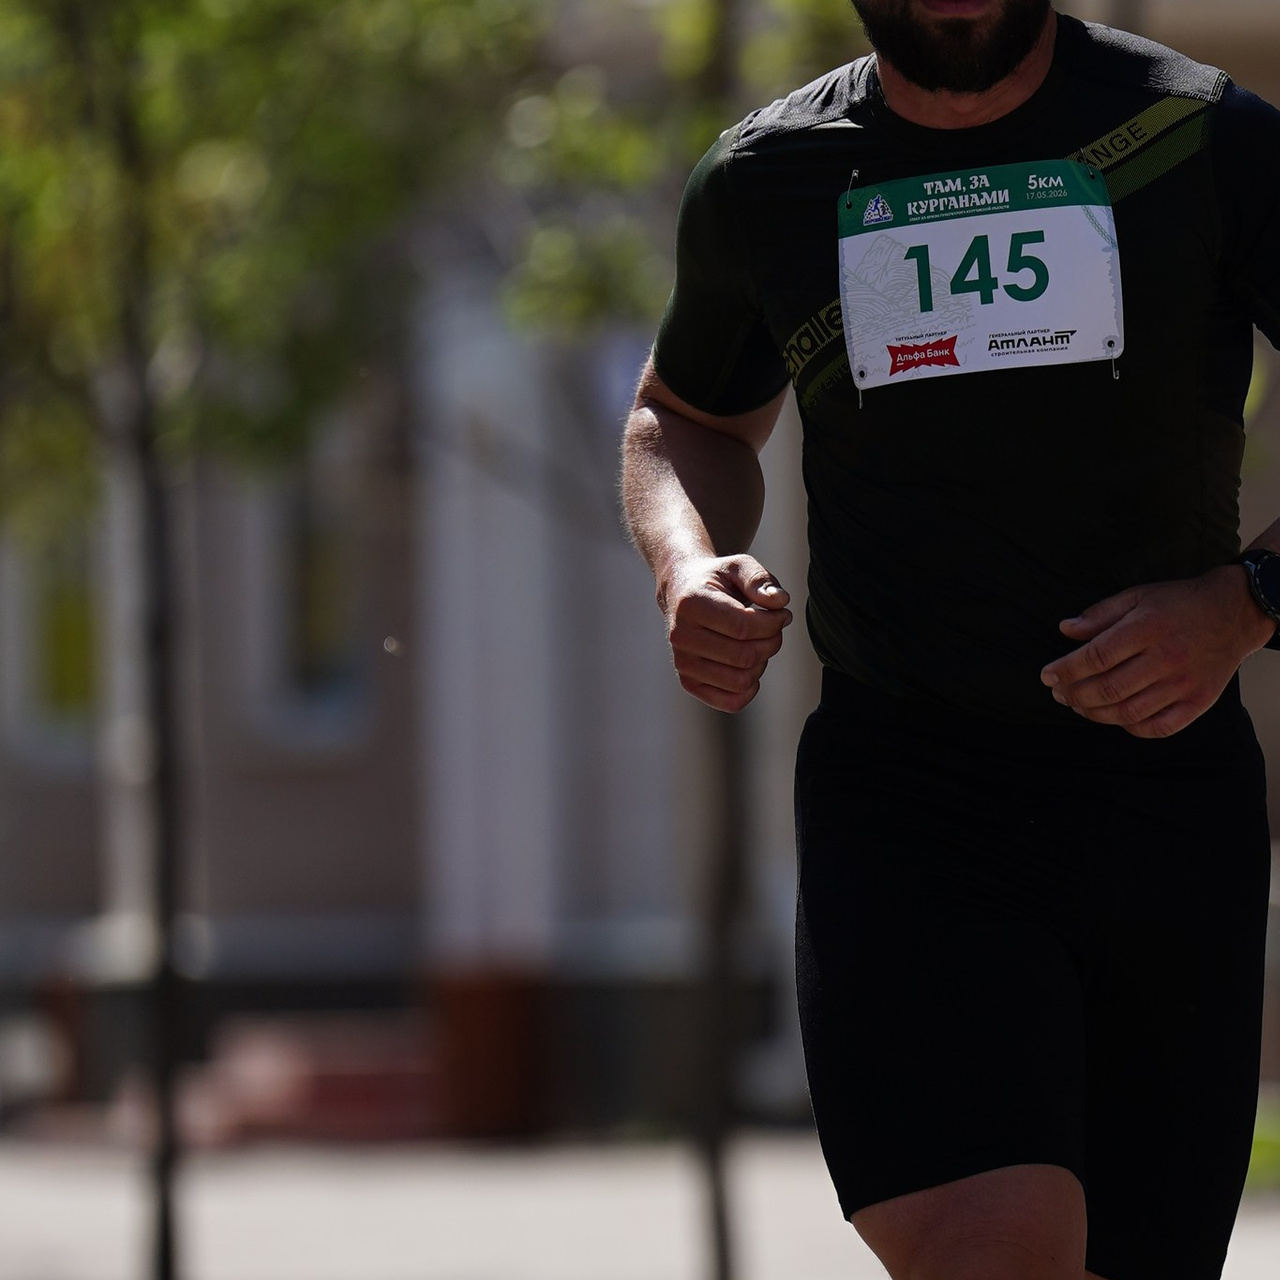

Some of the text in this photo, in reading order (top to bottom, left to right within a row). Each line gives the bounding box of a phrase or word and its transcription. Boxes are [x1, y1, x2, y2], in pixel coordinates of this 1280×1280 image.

[923, 174, 990, 195] ТАМ, ЗА
[1026, 189, 1068, 200] 17.05.2026
[907, 189, 1010, 216] КУРГАНАМИ
[903, 229, 1050, 314] 145
[895, 330, 948, 342] ТИТУЛЬНЫЙ ПАРТНЕР
[988, 329, 1026, 339] ГЕНЕРАЛЬНЫЙ
[896, 348, 950, 363] Альфа Банк
[990, 348, 1035, 357] строительная
